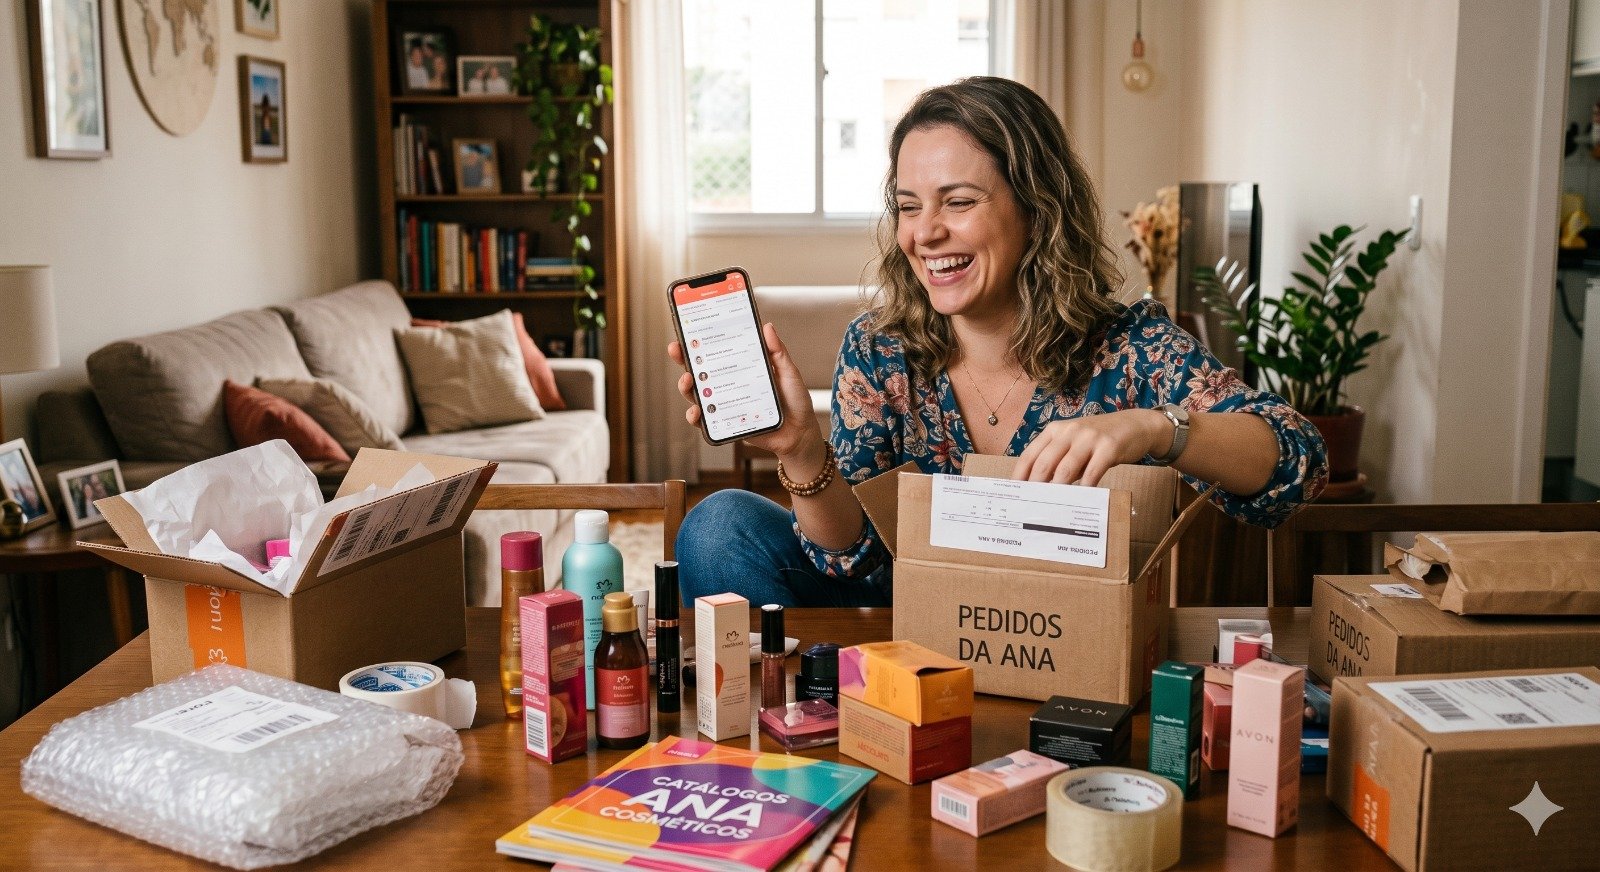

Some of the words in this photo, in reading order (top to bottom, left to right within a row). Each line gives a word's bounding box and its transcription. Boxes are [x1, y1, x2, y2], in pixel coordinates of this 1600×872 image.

[958, 604, 1062, 638] PEDIDOS
[1328, 610, 1370, 662] PEDIDOS
[959, 637, 992, 664] DA
[1000, 643, 1056, 672] ANA
[1326, 640, 1339, 672] DA
[1054, 704, 1108, 716] AVON
[1236, 728, 1274, 744] AVON
[652, 776, 790, 805] CATÁLOGOS
[599, 805, 754, 840] COSMÉTICOS
[620, 788, 764, 828] ANA
